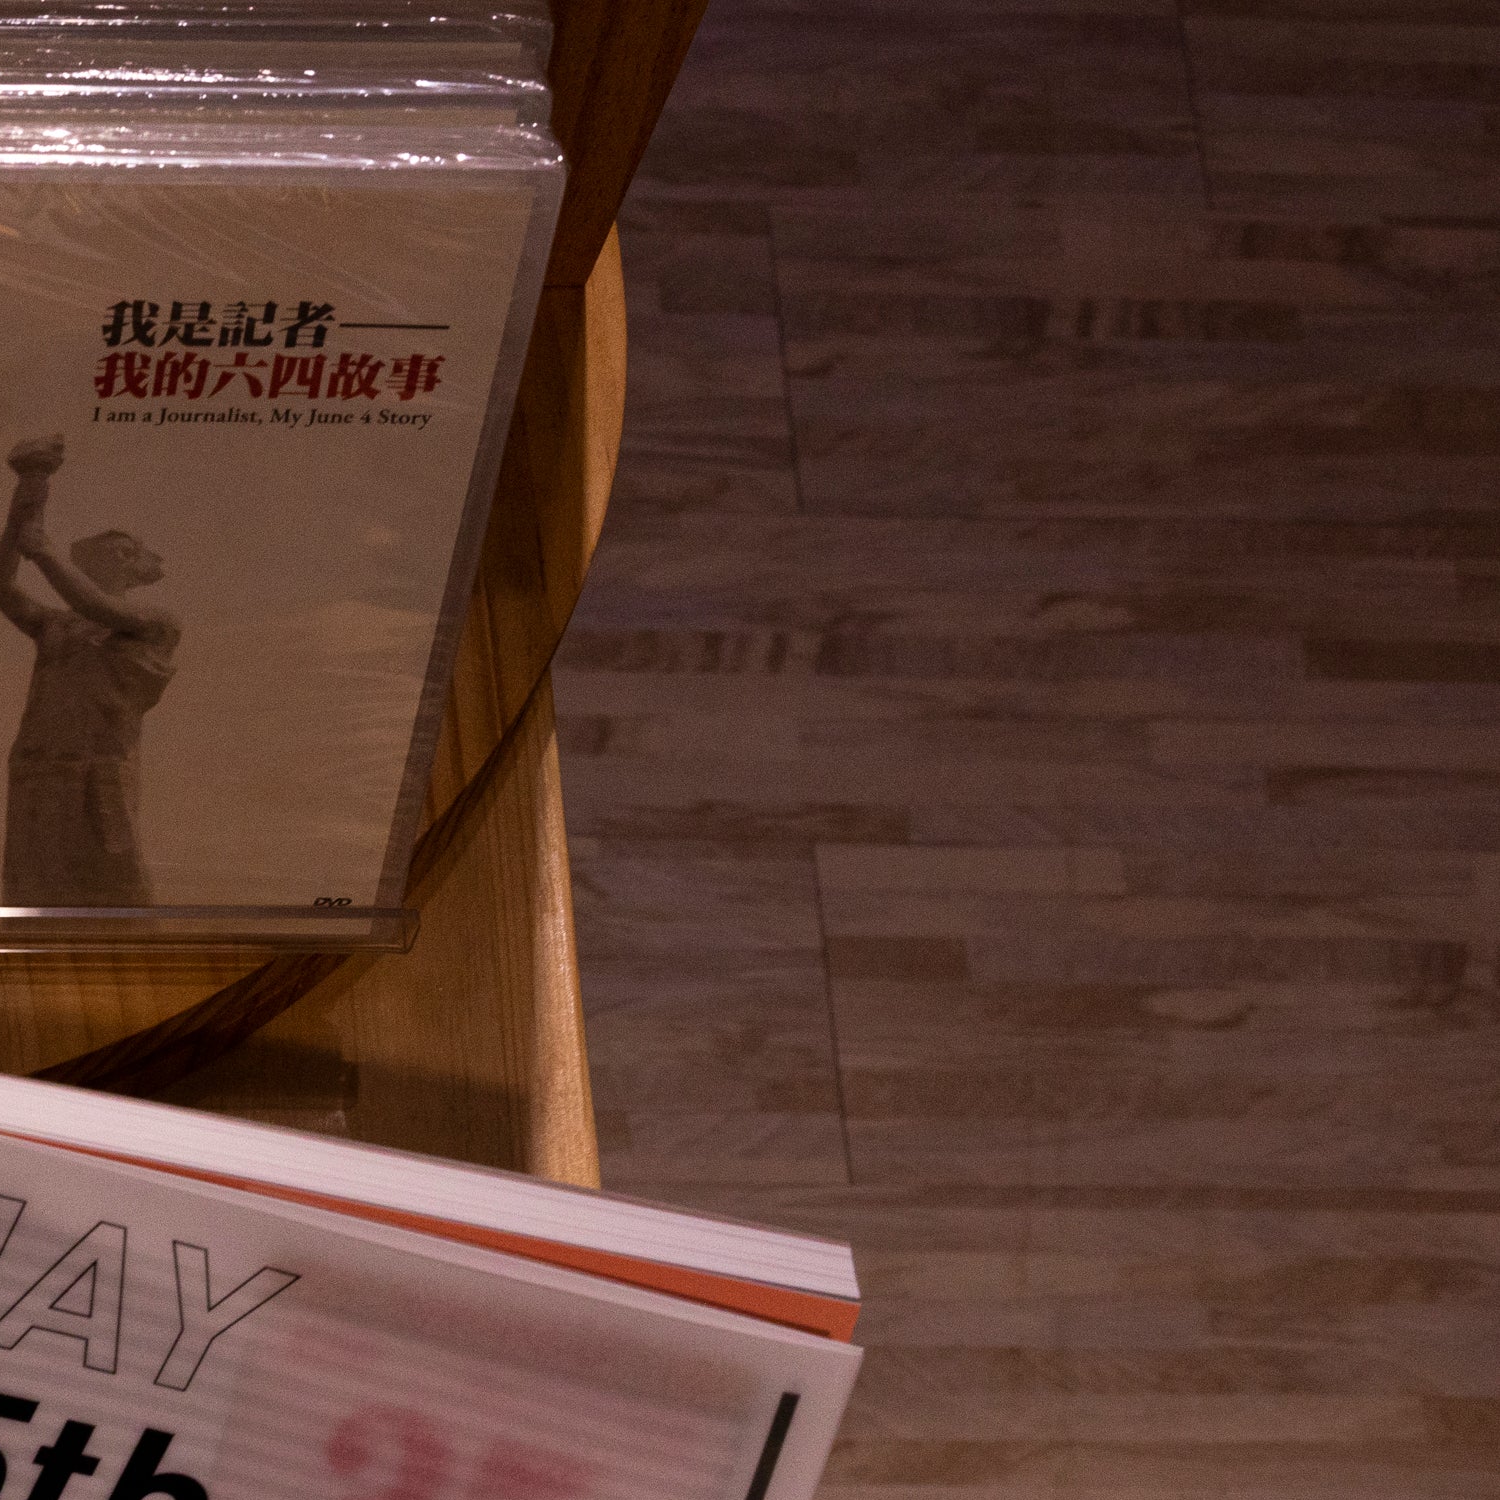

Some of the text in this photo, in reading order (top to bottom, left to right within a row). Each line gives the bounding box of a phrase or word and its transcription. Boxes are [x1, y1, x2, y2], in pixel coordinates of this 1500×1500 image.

[93, 351, 447, 401] 我的六四故事
[91, 405, 433, 430] I am a Journalist, My June 4 Story
